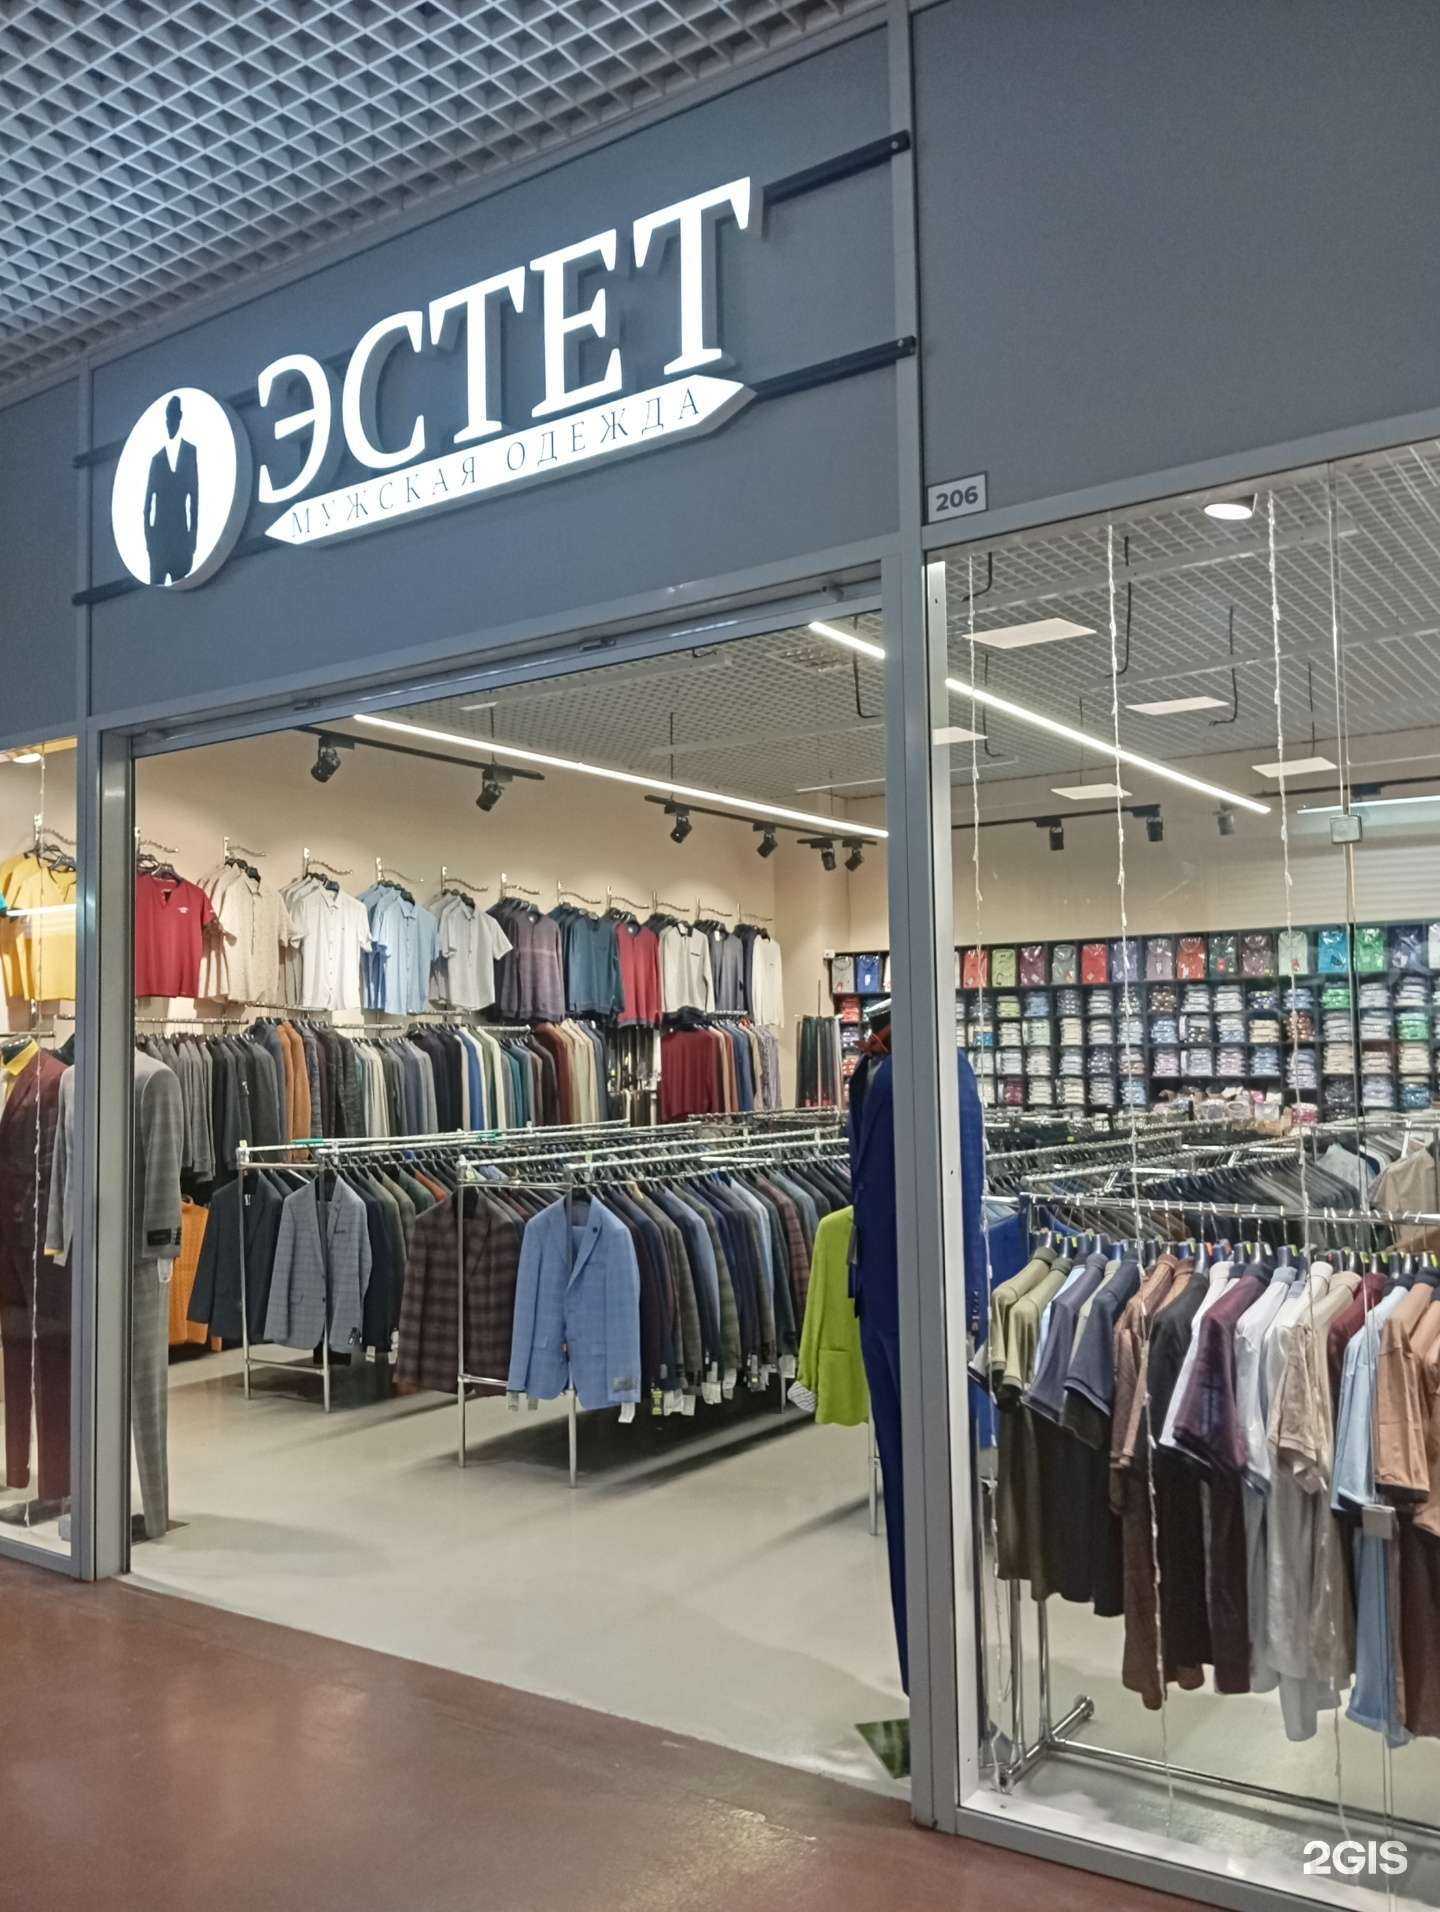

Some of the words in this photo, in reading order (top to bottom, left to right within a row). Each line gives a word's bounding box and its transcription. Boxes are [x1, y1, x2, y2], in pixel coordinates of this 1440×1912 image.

[257, 176, 751, 504] ЭСТЕТ
[290, 455, 477, 538] МУЖСКАЯ
[505, 386, 700, 472] ОДЕЖДА
[936, 485, 978, 512] 206
